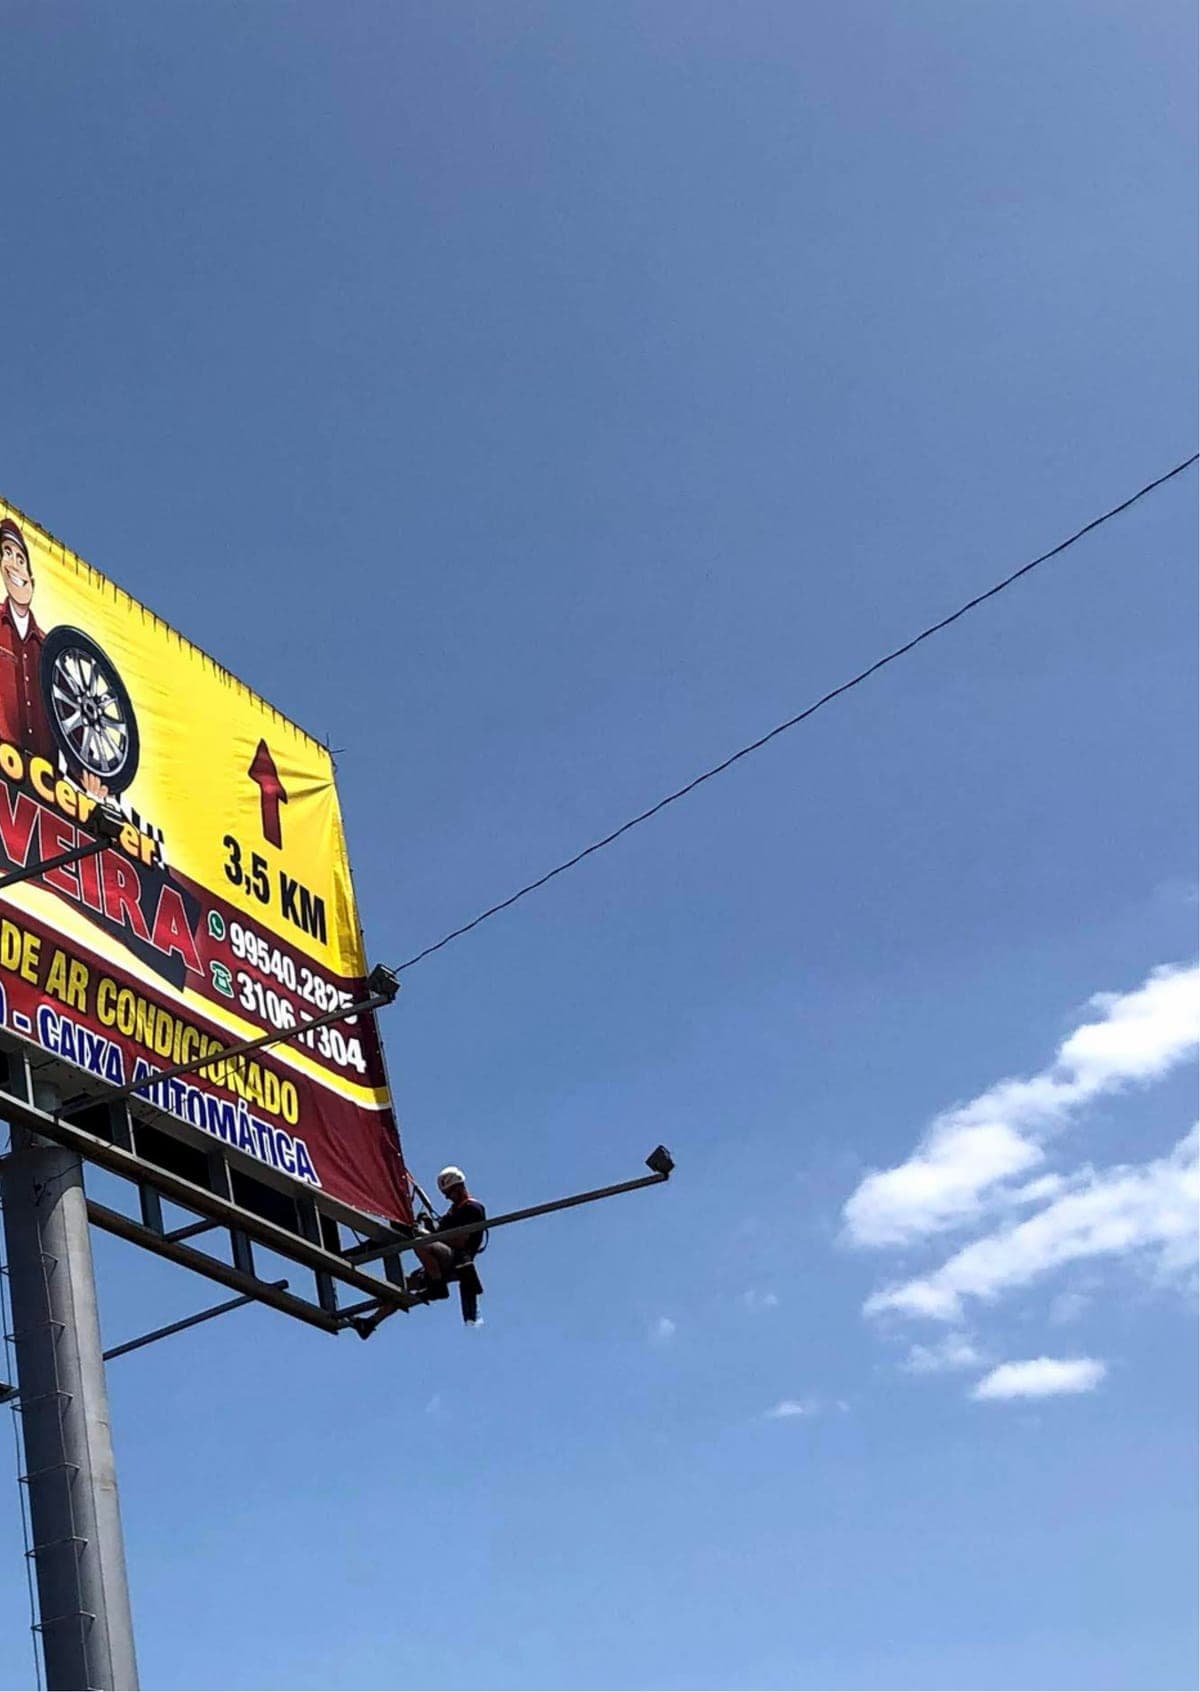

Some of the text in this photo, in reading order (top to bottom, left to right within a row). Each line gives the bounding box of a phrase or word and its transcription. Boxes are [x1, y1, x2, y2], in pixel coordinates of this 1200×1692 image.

[29, 757, 154, 866] Cener
[223, 835, 327, 945] 3,5 KM
[0, 918, 41, 985] DE
[45, 950, 89, 1013] AR
[97, 978, 298, 1125] CONDICIONADO
[230, 923, 357, 1025] 99540.2825
[37, 1004, 126, 1087] CAIXA
